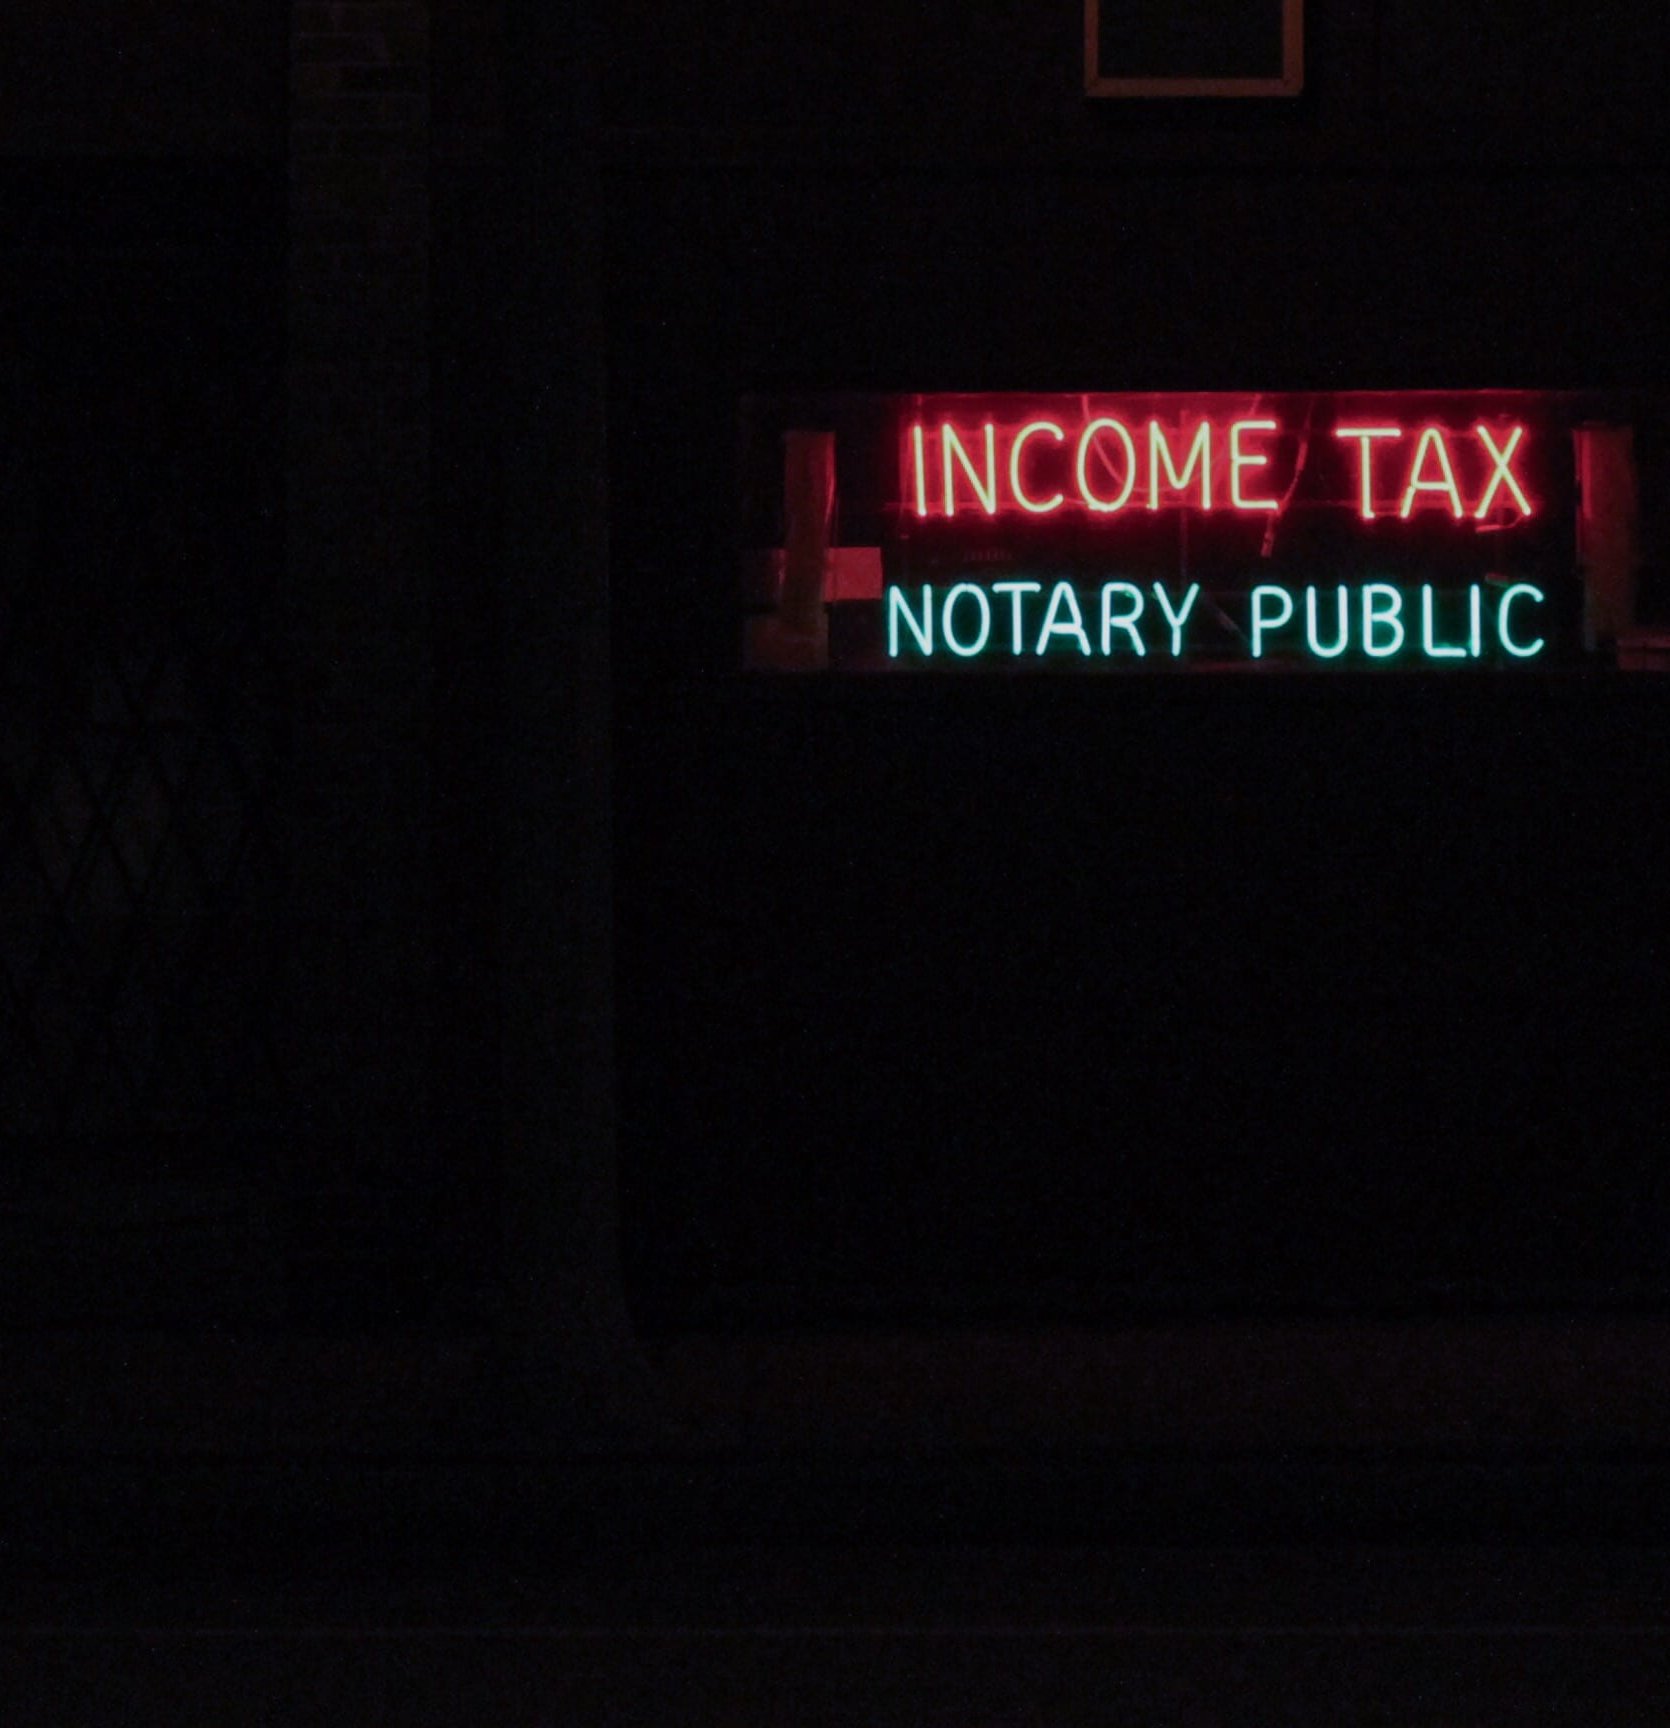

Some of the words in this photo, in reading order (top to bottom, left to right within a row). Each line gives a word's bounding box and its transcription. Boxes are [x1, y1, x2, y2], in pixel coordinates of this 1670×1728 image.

[912, 416, 1280, 518] INCOME
[1334, 424, 1533, 520] TAX
[887, 580, 1201, 659] NOTARY
[1249, 582, 1546, 660] PUBLIC
